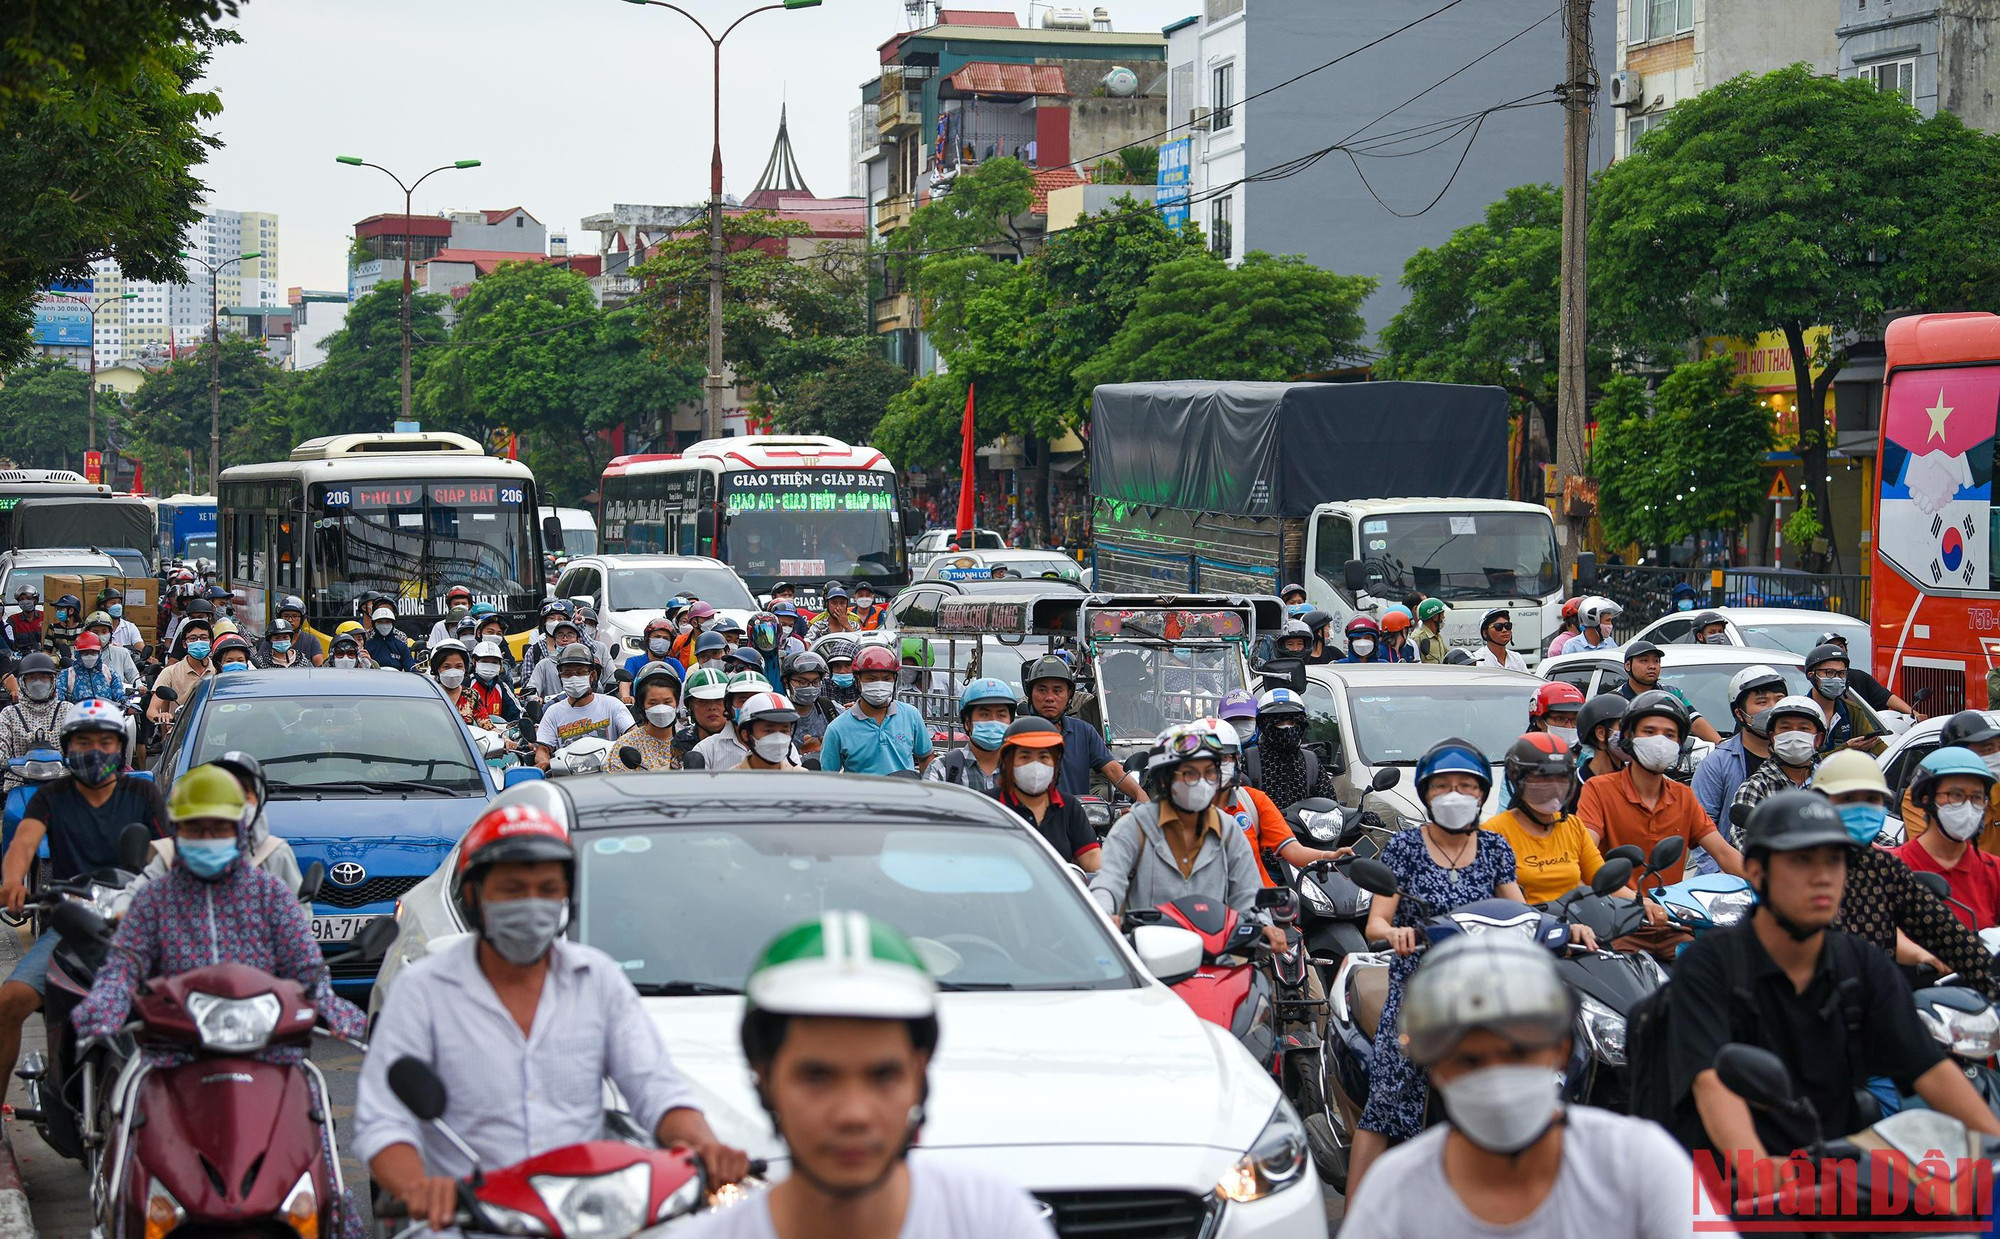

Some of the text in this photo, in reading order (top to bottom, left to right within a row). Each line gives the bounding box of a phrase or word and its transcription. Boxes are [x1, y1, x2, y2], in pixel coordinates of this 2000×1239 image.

[802, 457, 820, 467] VIP
[733, 474, 768, 486] GIAO
[771, 471, 812, 488] THIỆN
[821, 472, 855, 486] GIÁP
[858, 472, 885, 487] BÁT
[326, 490, 350, 505] 206
[501, 488, 523, 503] 206
[794, 596, 816, 606] GIAO
[1427, 605, 1439, 614] Grab
[1967, 607, 2000, 630] 75B-
